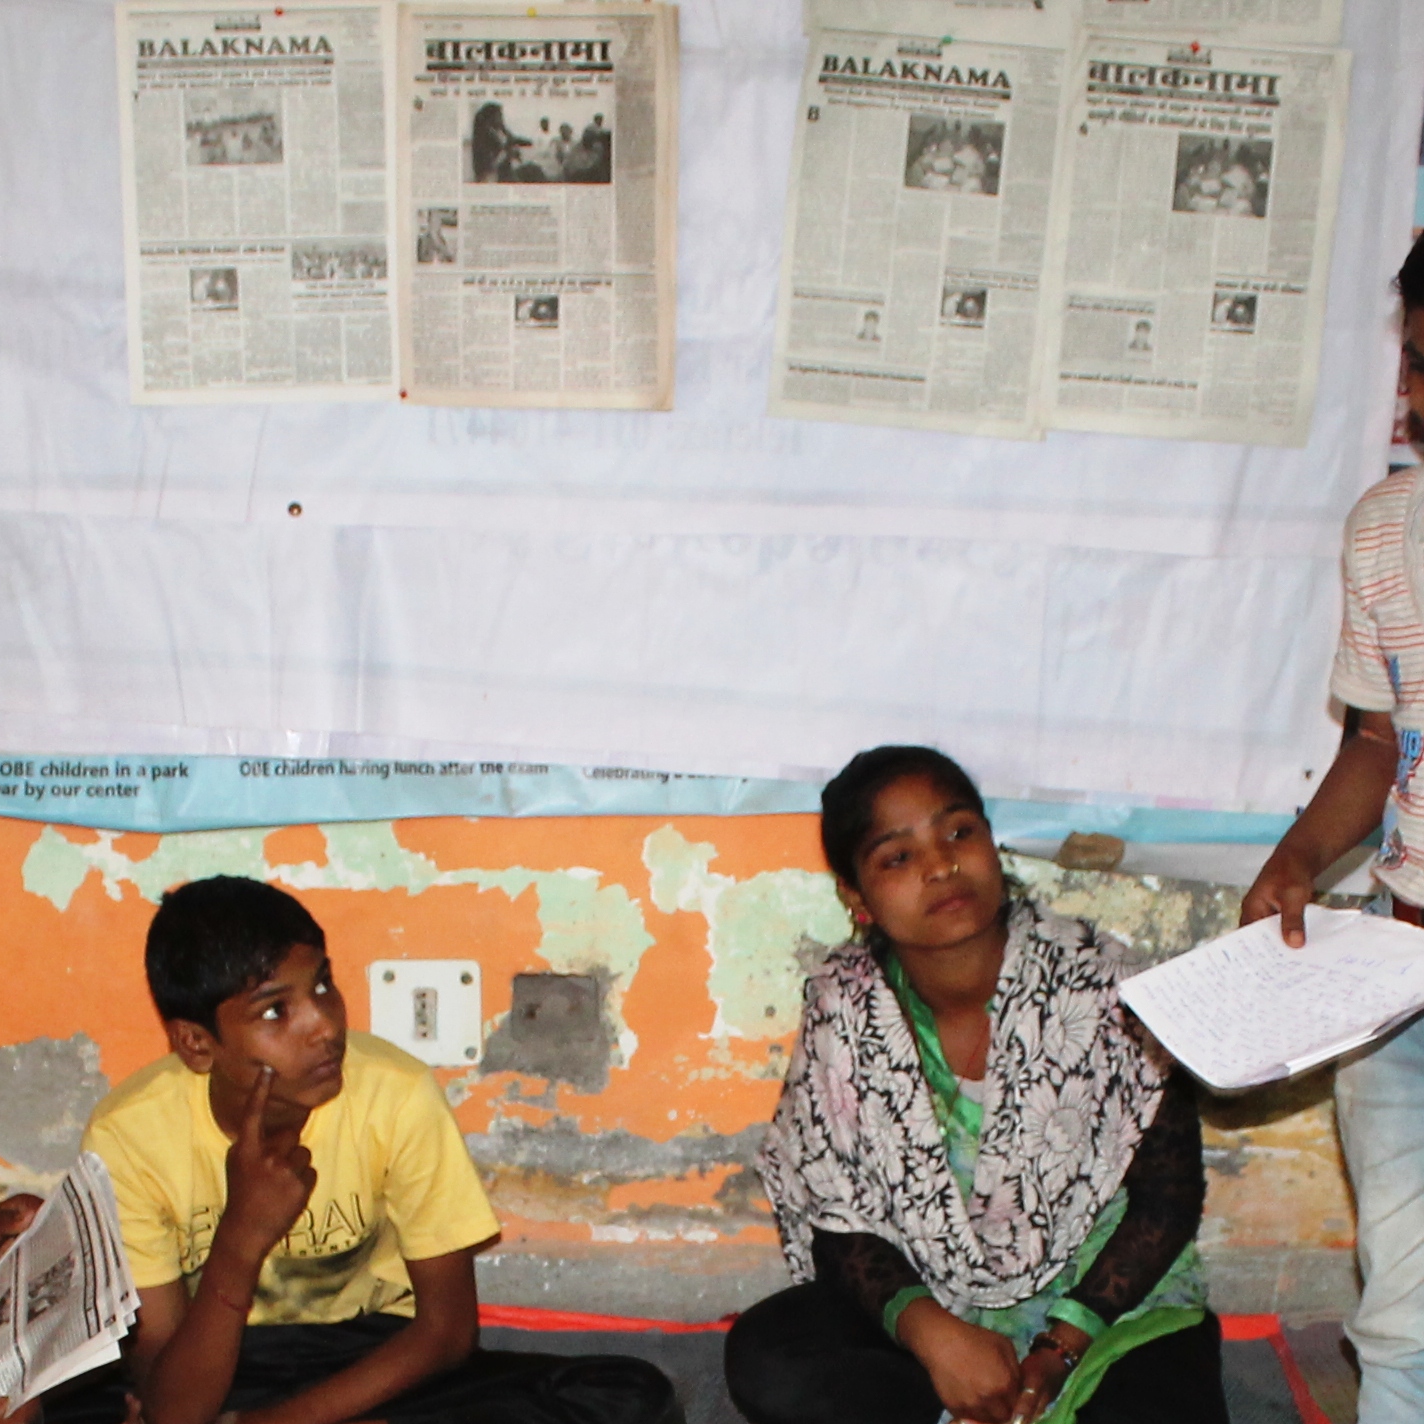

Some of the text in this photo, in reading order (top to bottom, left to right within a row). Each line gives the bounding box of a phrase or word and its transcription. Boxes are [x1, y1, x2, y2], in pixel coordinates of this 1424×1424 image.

[138, 35, 333, 57] BALAKNAMA
[425, 38, 611, 61] बालकनामा
[821, 54, 1011, 89] BALAKNAMA
[1088, 60, 1281, 96] बालकनामा
[0, 762, 33, 779] OBE
[40, 761, 110, 779] children
[115, 762, 130, 779] in
[151, 762, 189, 782] park
[275, 760, 335, 776] children
[24, 782, 45, 801] by
[50, 784, 81, 799] our
[86, 782, 140, 799] center
